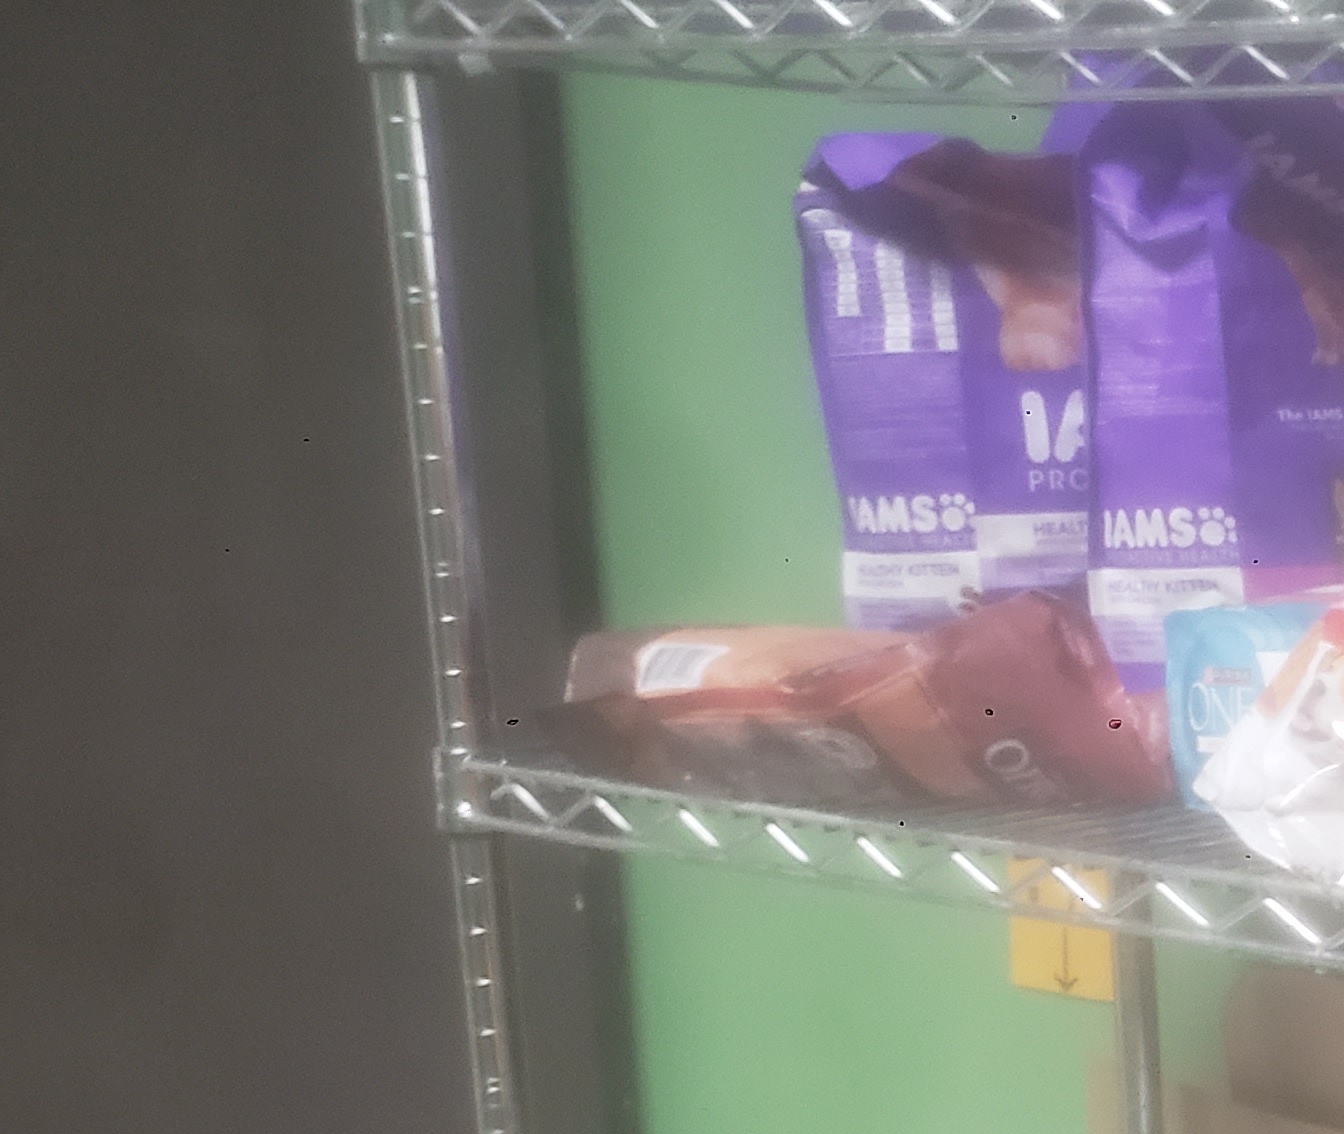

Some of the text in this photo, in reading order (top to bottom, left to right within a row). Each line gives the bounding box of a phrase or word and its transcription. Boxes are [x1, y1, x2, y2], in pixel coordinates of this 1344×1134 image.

[1306, 406, 1344, 422] IAMS
[849, 494, 938, 534] IAMS
[1103, 507, 1196, 549] IAMS
